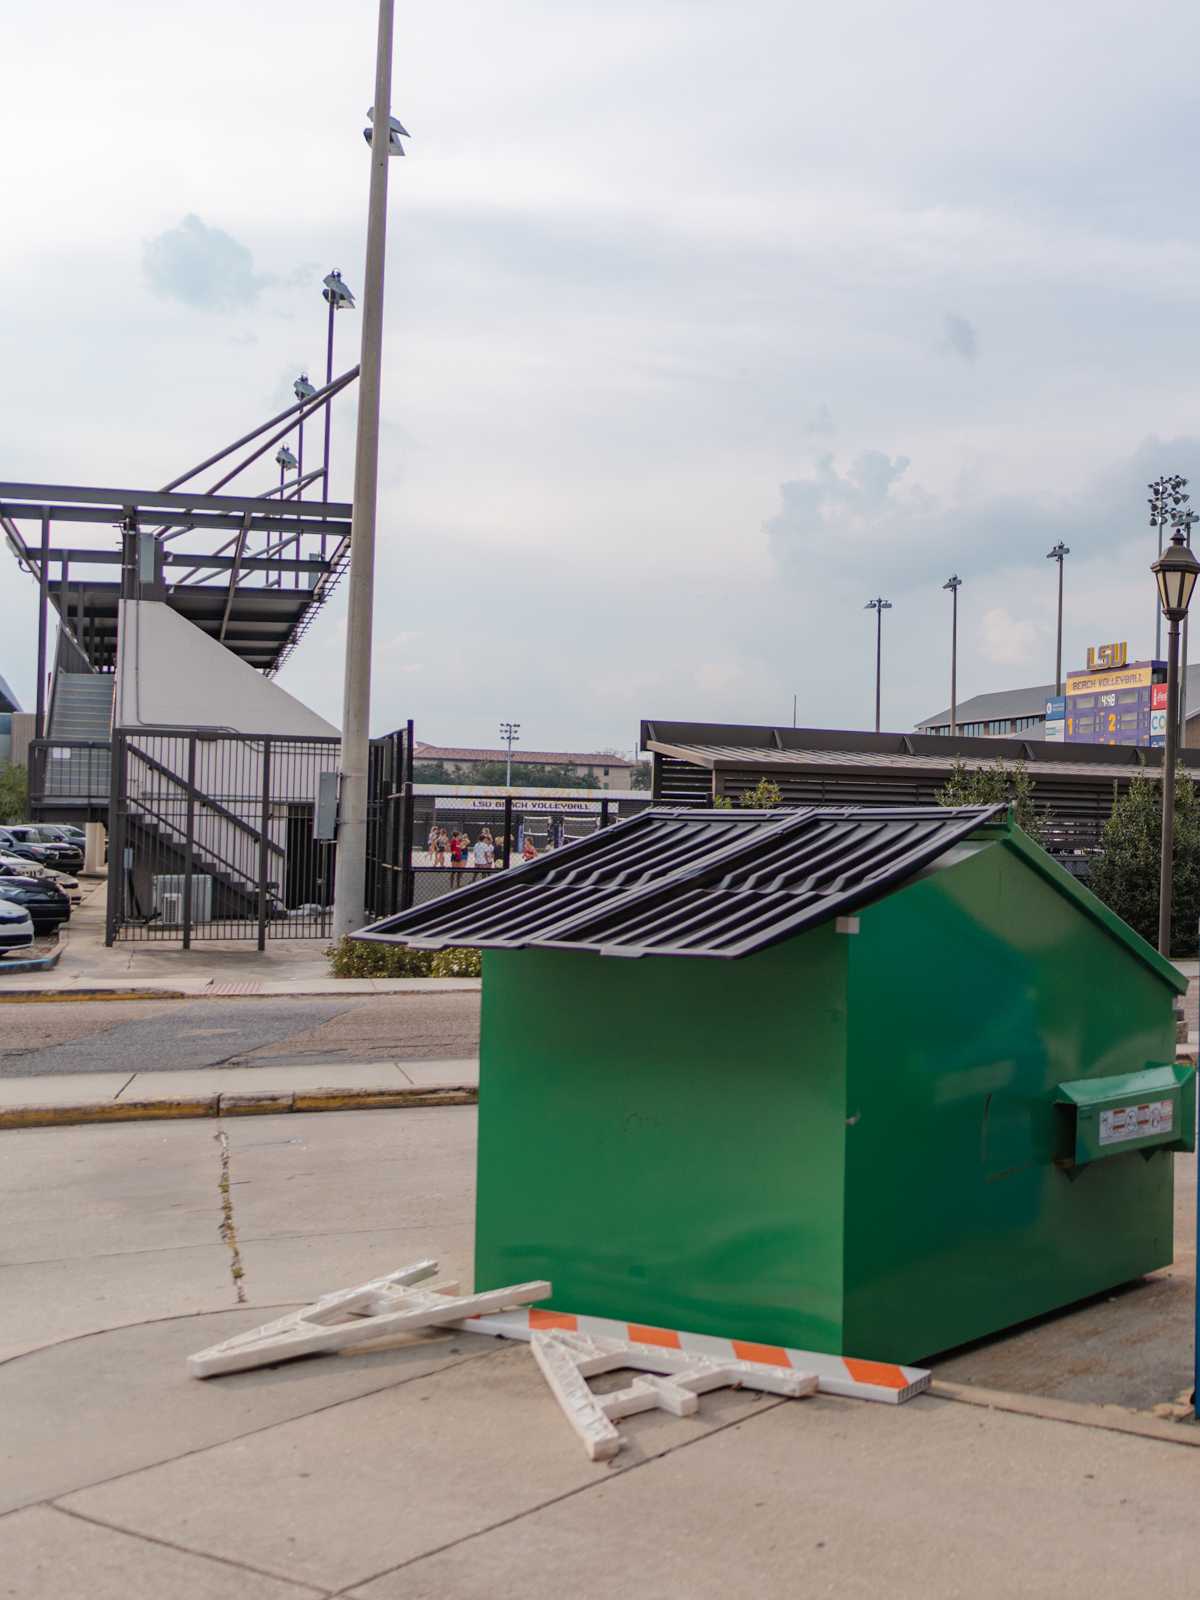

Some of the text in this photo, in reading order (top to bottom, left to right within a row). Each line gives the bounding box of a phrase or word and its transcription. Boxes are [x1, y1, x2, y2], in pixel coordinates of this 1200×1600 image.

[1087, 641, 1127, 670] LSU
[1072, 673, 1144, 691] BEACH VOLLEYBALL
[1067, 718, 1073, 736] 1
[1107, 713, 1116, 732] 2
[1152, 715, 1167, 730] CO
[473, 800, 491, 808] LSU
[531, 802, 589, 810] VOLLEYBALL
